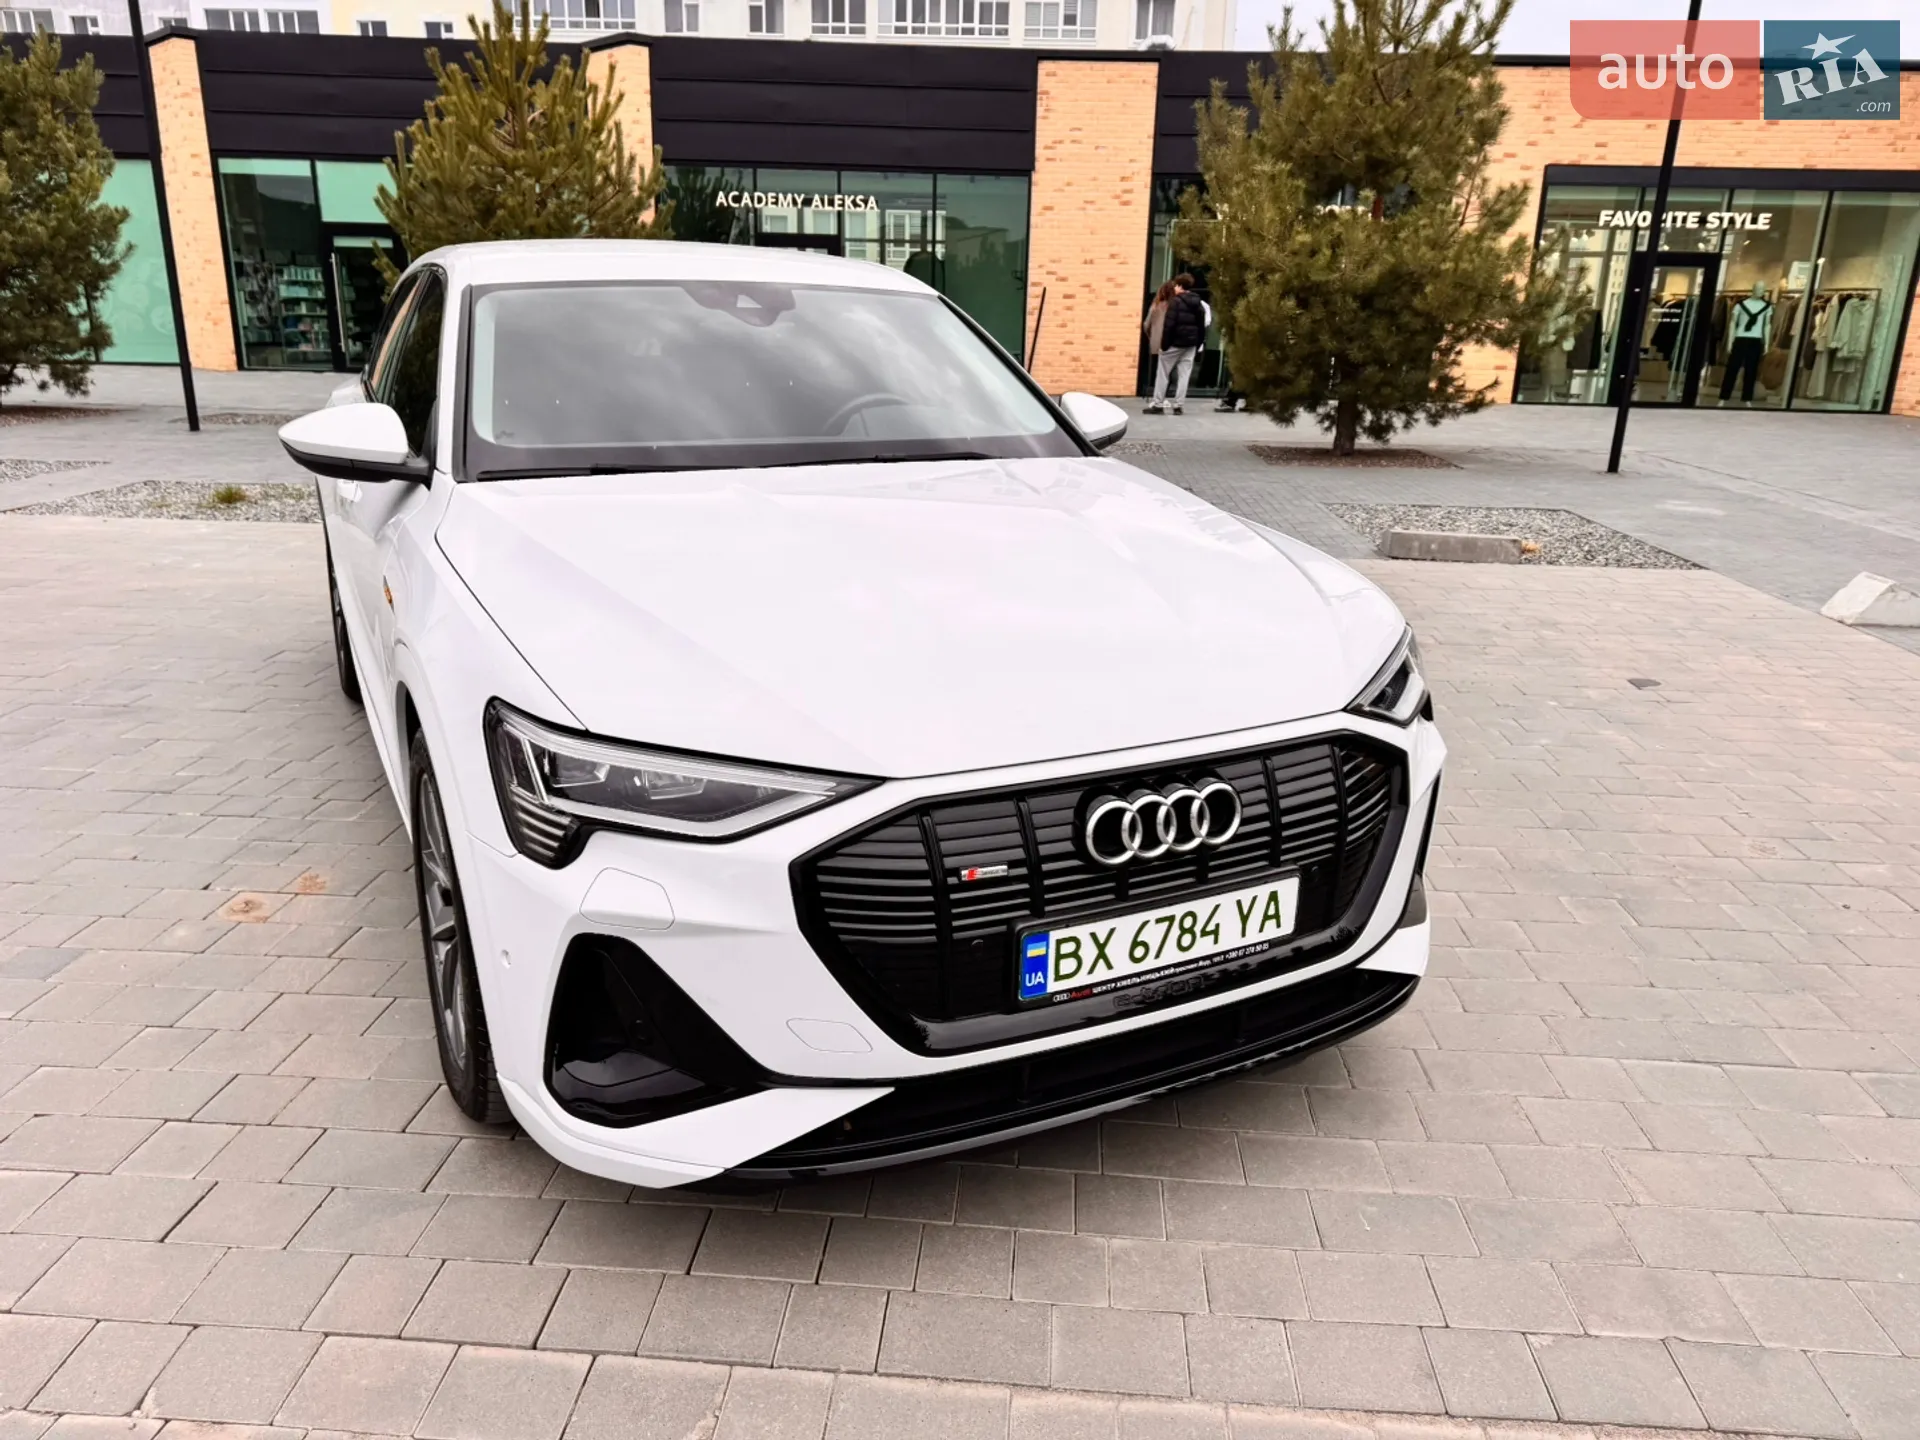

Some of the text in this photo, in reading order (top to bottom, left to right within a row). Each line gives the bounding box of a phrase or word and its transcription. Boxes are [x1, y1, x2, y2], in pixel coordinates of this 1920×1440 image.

[716, 191, 879, 212] ACADEMY ALEKSA
[1598, 209, 1773, 230] FAVOITE STYLE
[1053, 890, 1282, 983] BX 6784 YA
[1025, 971, 1046, 988] UA
